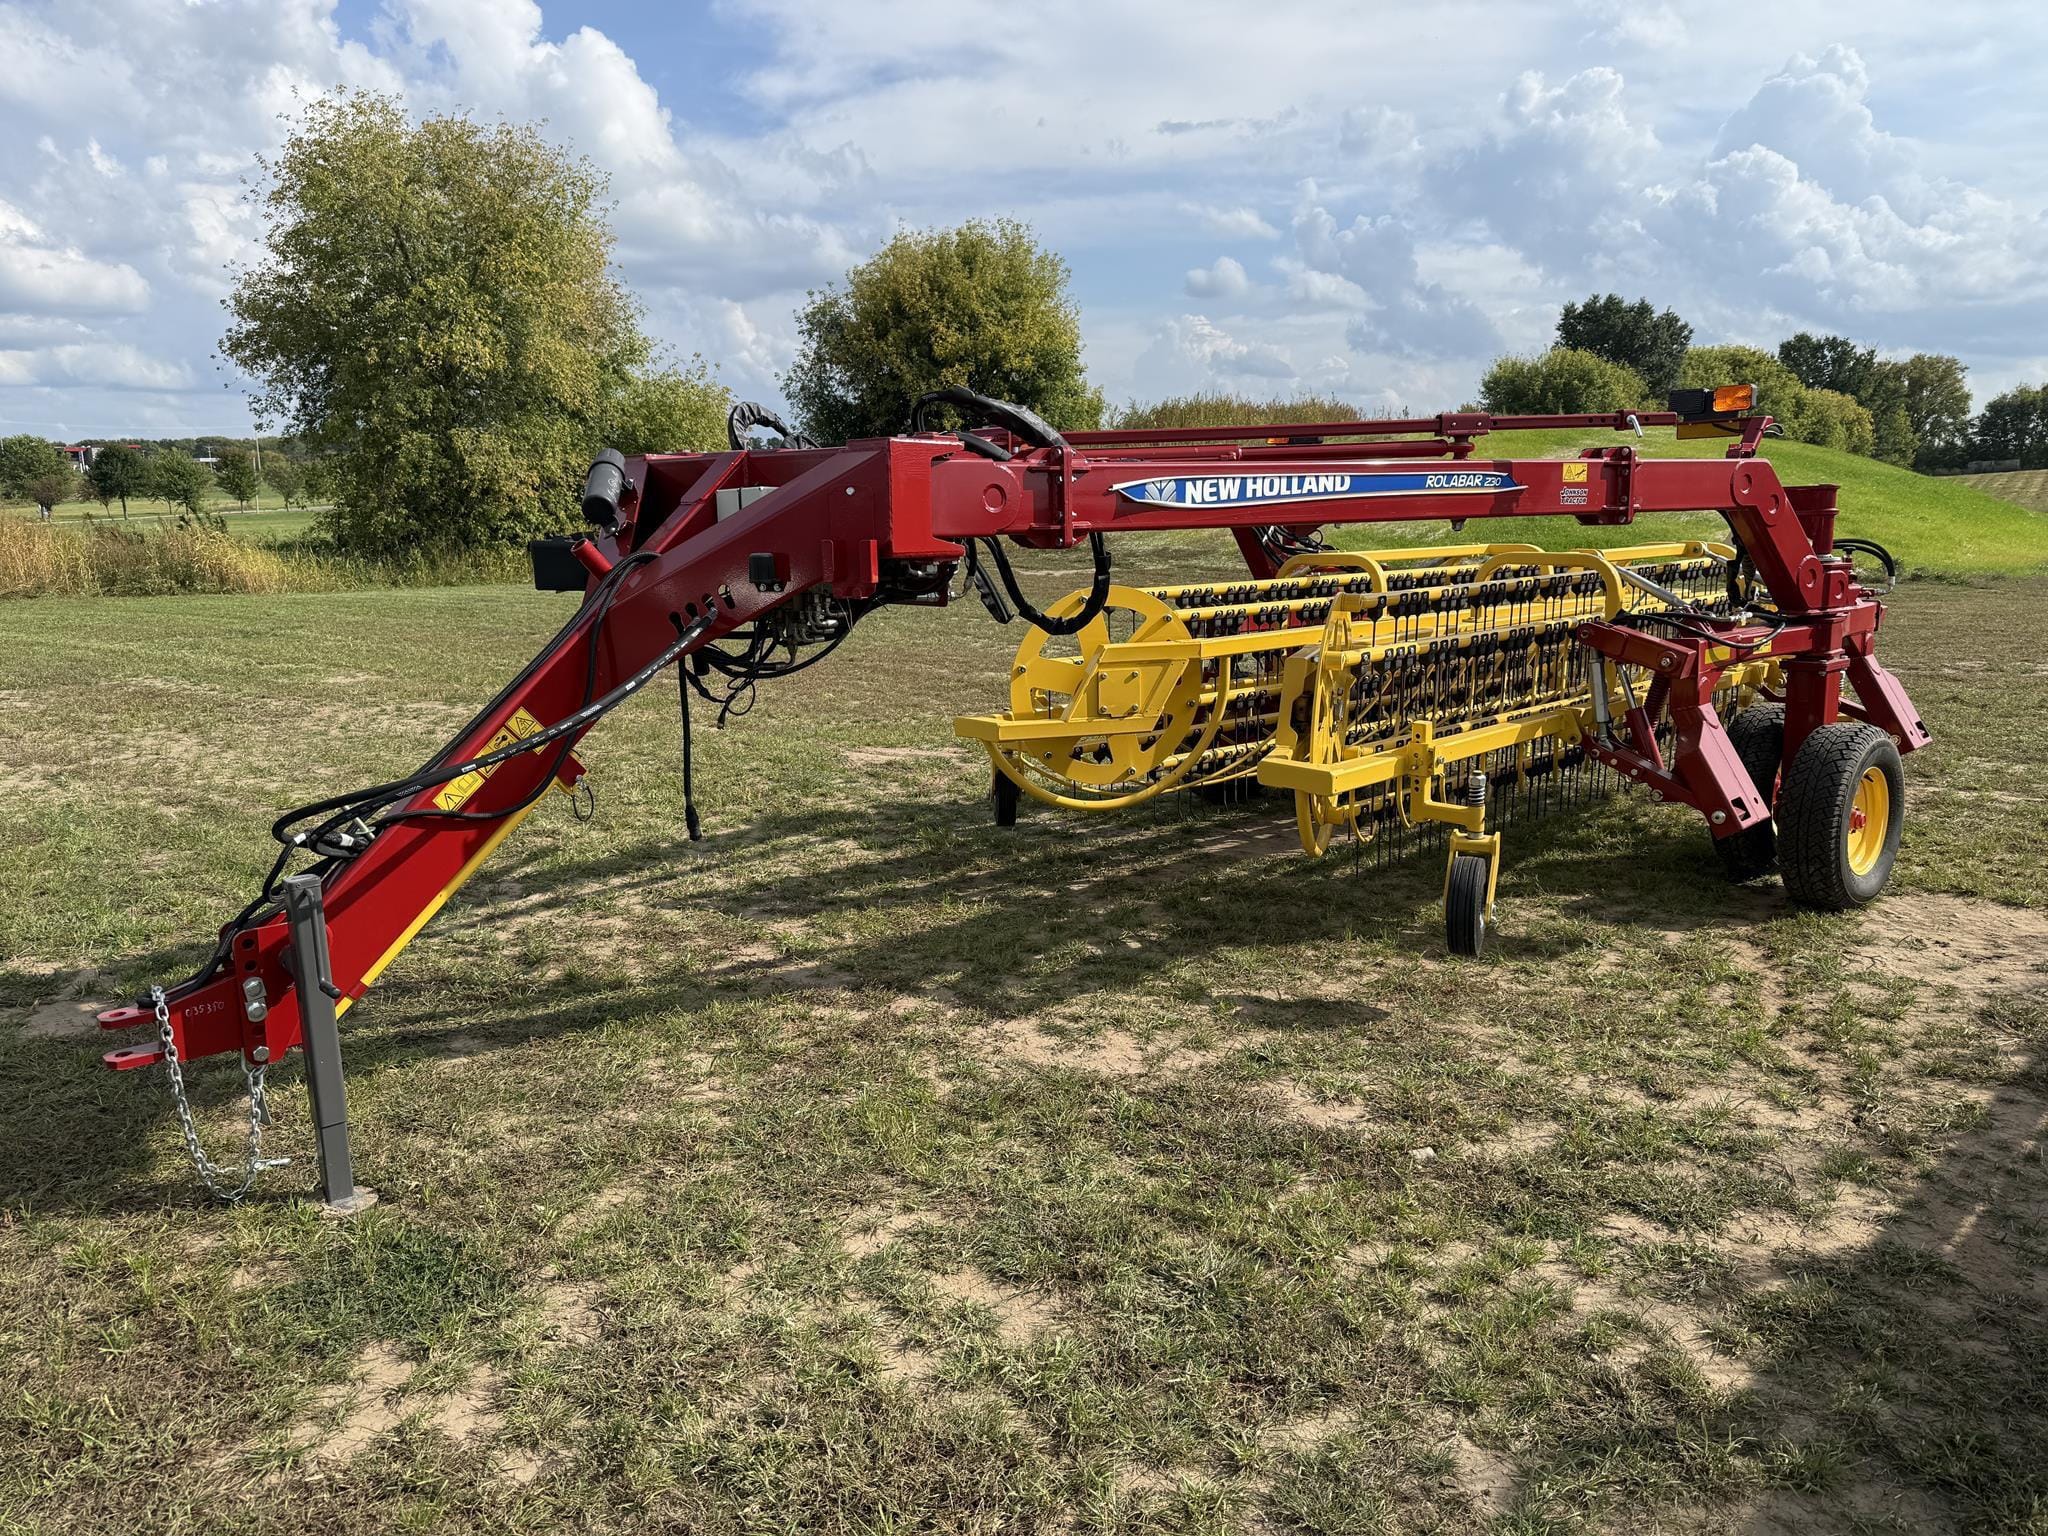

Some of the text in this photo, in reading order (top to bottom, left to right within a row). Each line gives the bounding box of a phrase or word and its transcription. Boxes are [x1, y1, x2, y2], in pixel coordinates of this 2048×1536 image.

[1185, 475, 1351, 504] NEW HOLLAND
[1425, 474, 1502, 488] ROLABAR 230
